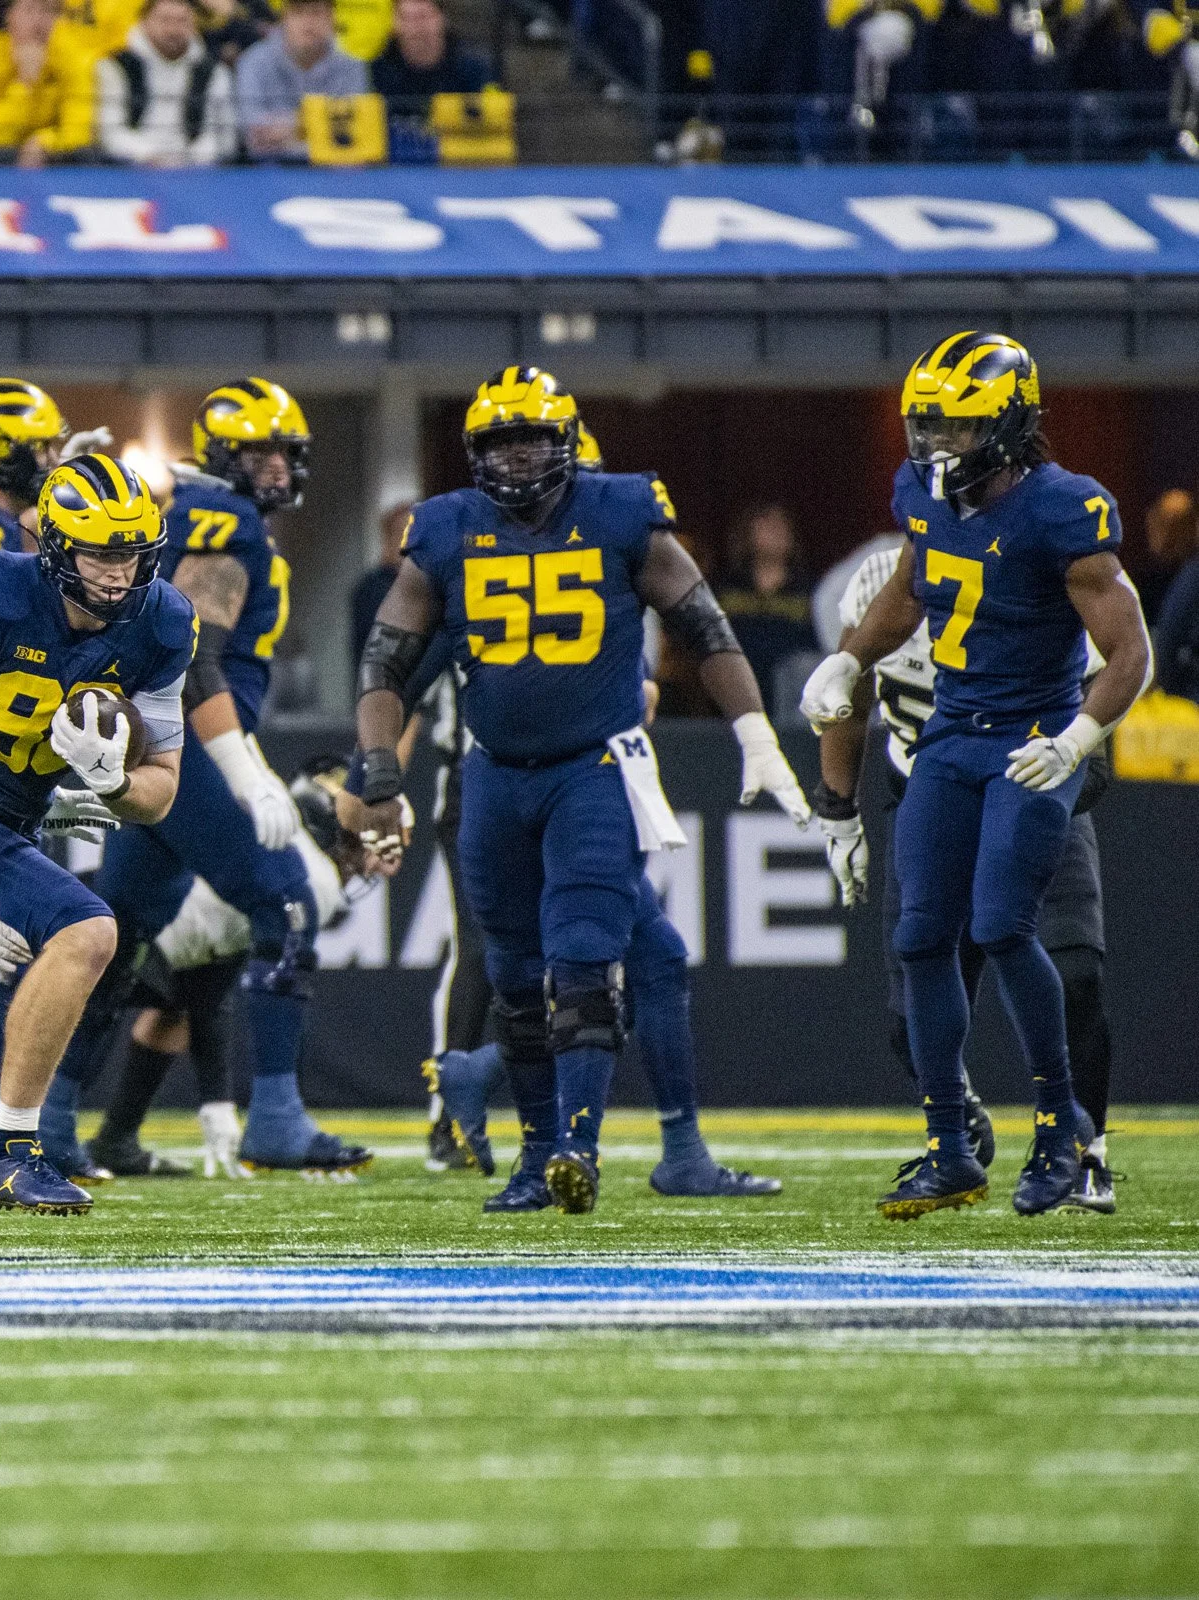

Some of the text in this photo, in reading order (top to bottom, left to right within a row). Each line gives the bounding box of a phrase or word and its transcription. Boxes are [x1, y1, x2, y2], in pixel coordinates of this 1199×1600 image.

[271, 195, 1199, 251] STADI
[187, 507, 238, 549] 77
[1085, 496, 1110, 541] 7
[464, 548, 605, 665] 55
[926, 548, 984, 670] 7
[619, 737, 648, 758] M
